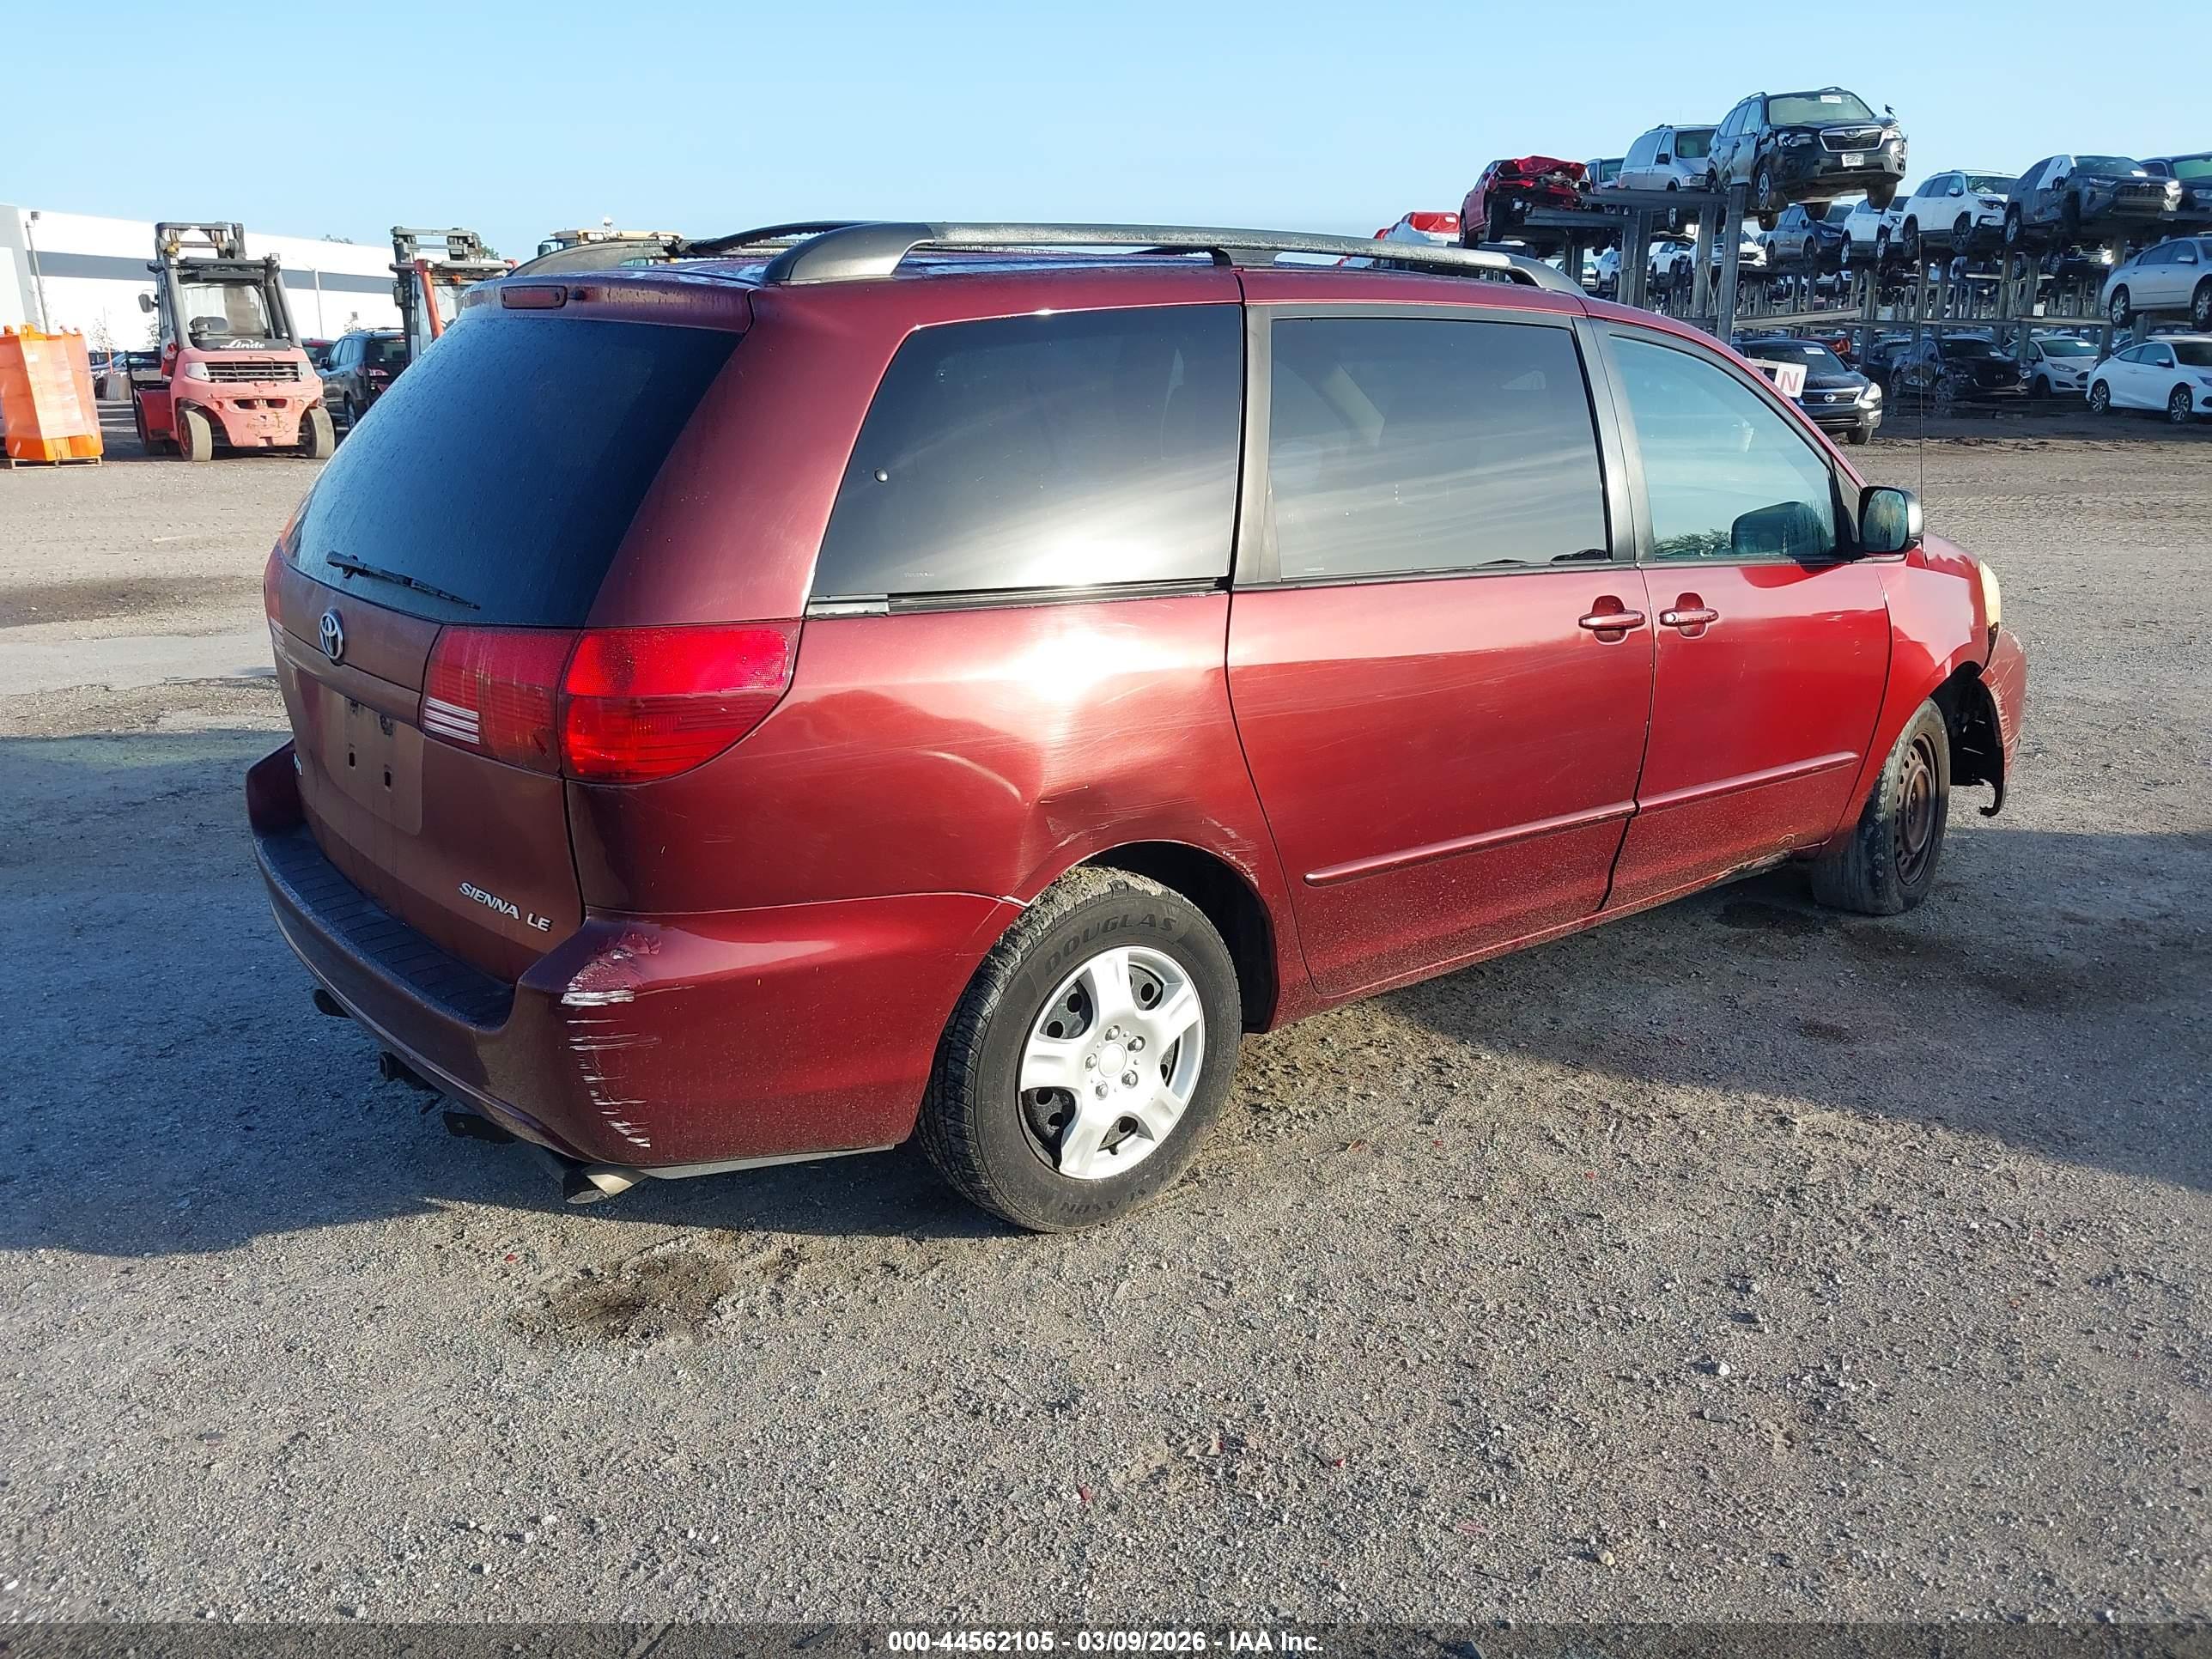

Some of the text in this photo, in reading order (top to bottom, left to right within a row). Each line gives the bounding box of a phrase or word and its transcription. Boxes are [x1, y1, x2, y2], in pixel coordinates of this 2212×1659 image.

[219, 338, 265, 349] Linde
[1779, 370, 1800, 392] N
[459, 882, 552, 933] SIENNA LE
[1044, 913, 1177, 977] DOUGLAS
